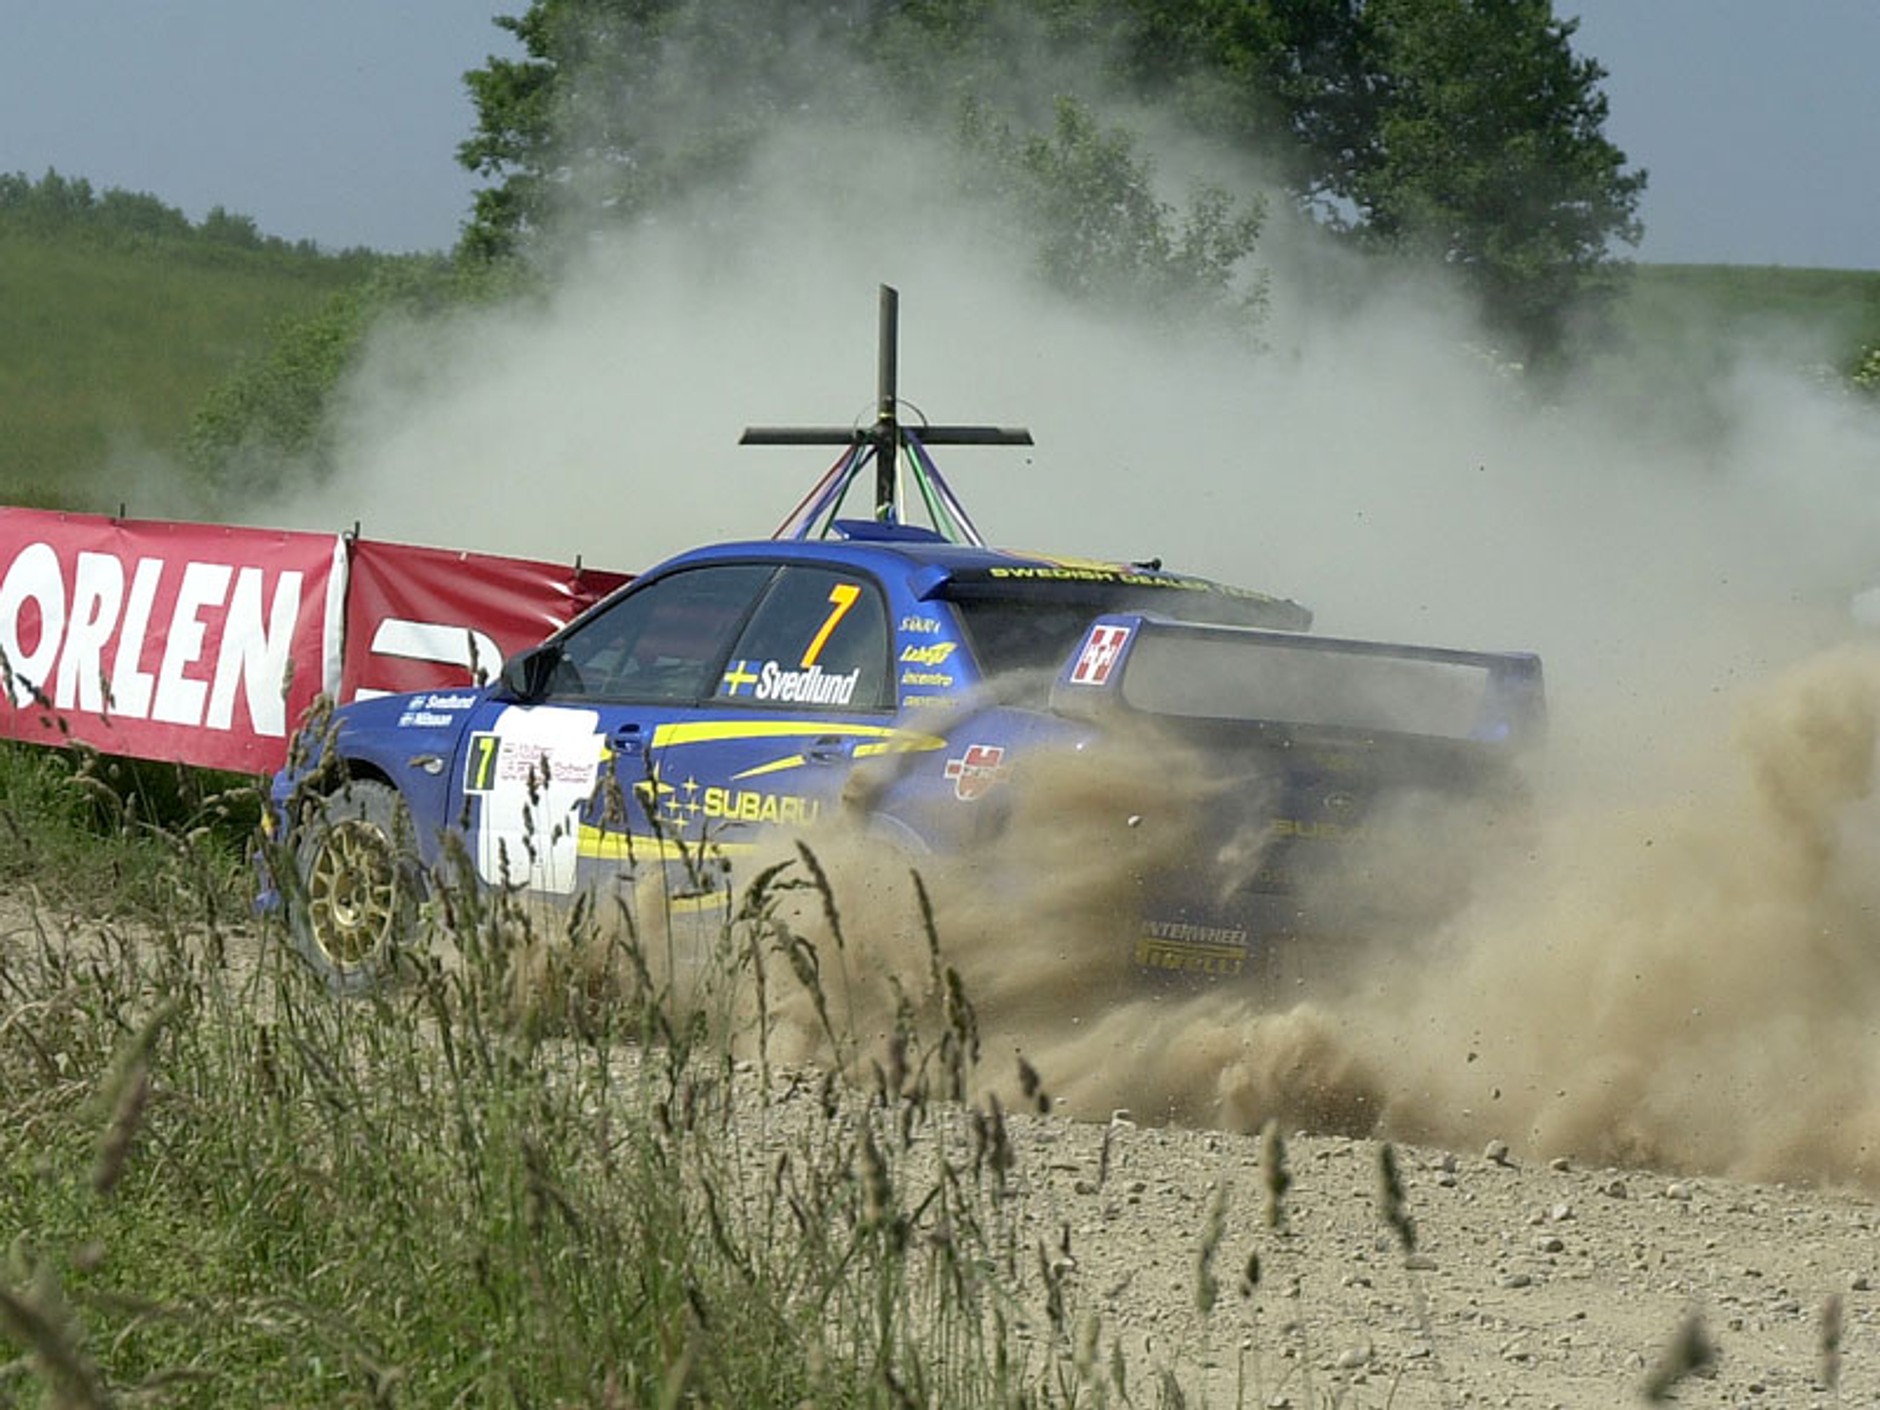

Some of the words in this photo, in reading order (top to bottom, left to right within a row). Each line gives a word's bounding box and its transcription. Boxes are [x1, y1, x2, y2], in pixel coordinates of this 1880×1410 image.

[0, 542, 303, 737] ORLEN
[801, 584, 861, 668] 7
[756, 661, 860, 704] Svedlund
[475, 738, 495, 789] 7
[704, 786, 819, 825] SUBARU
